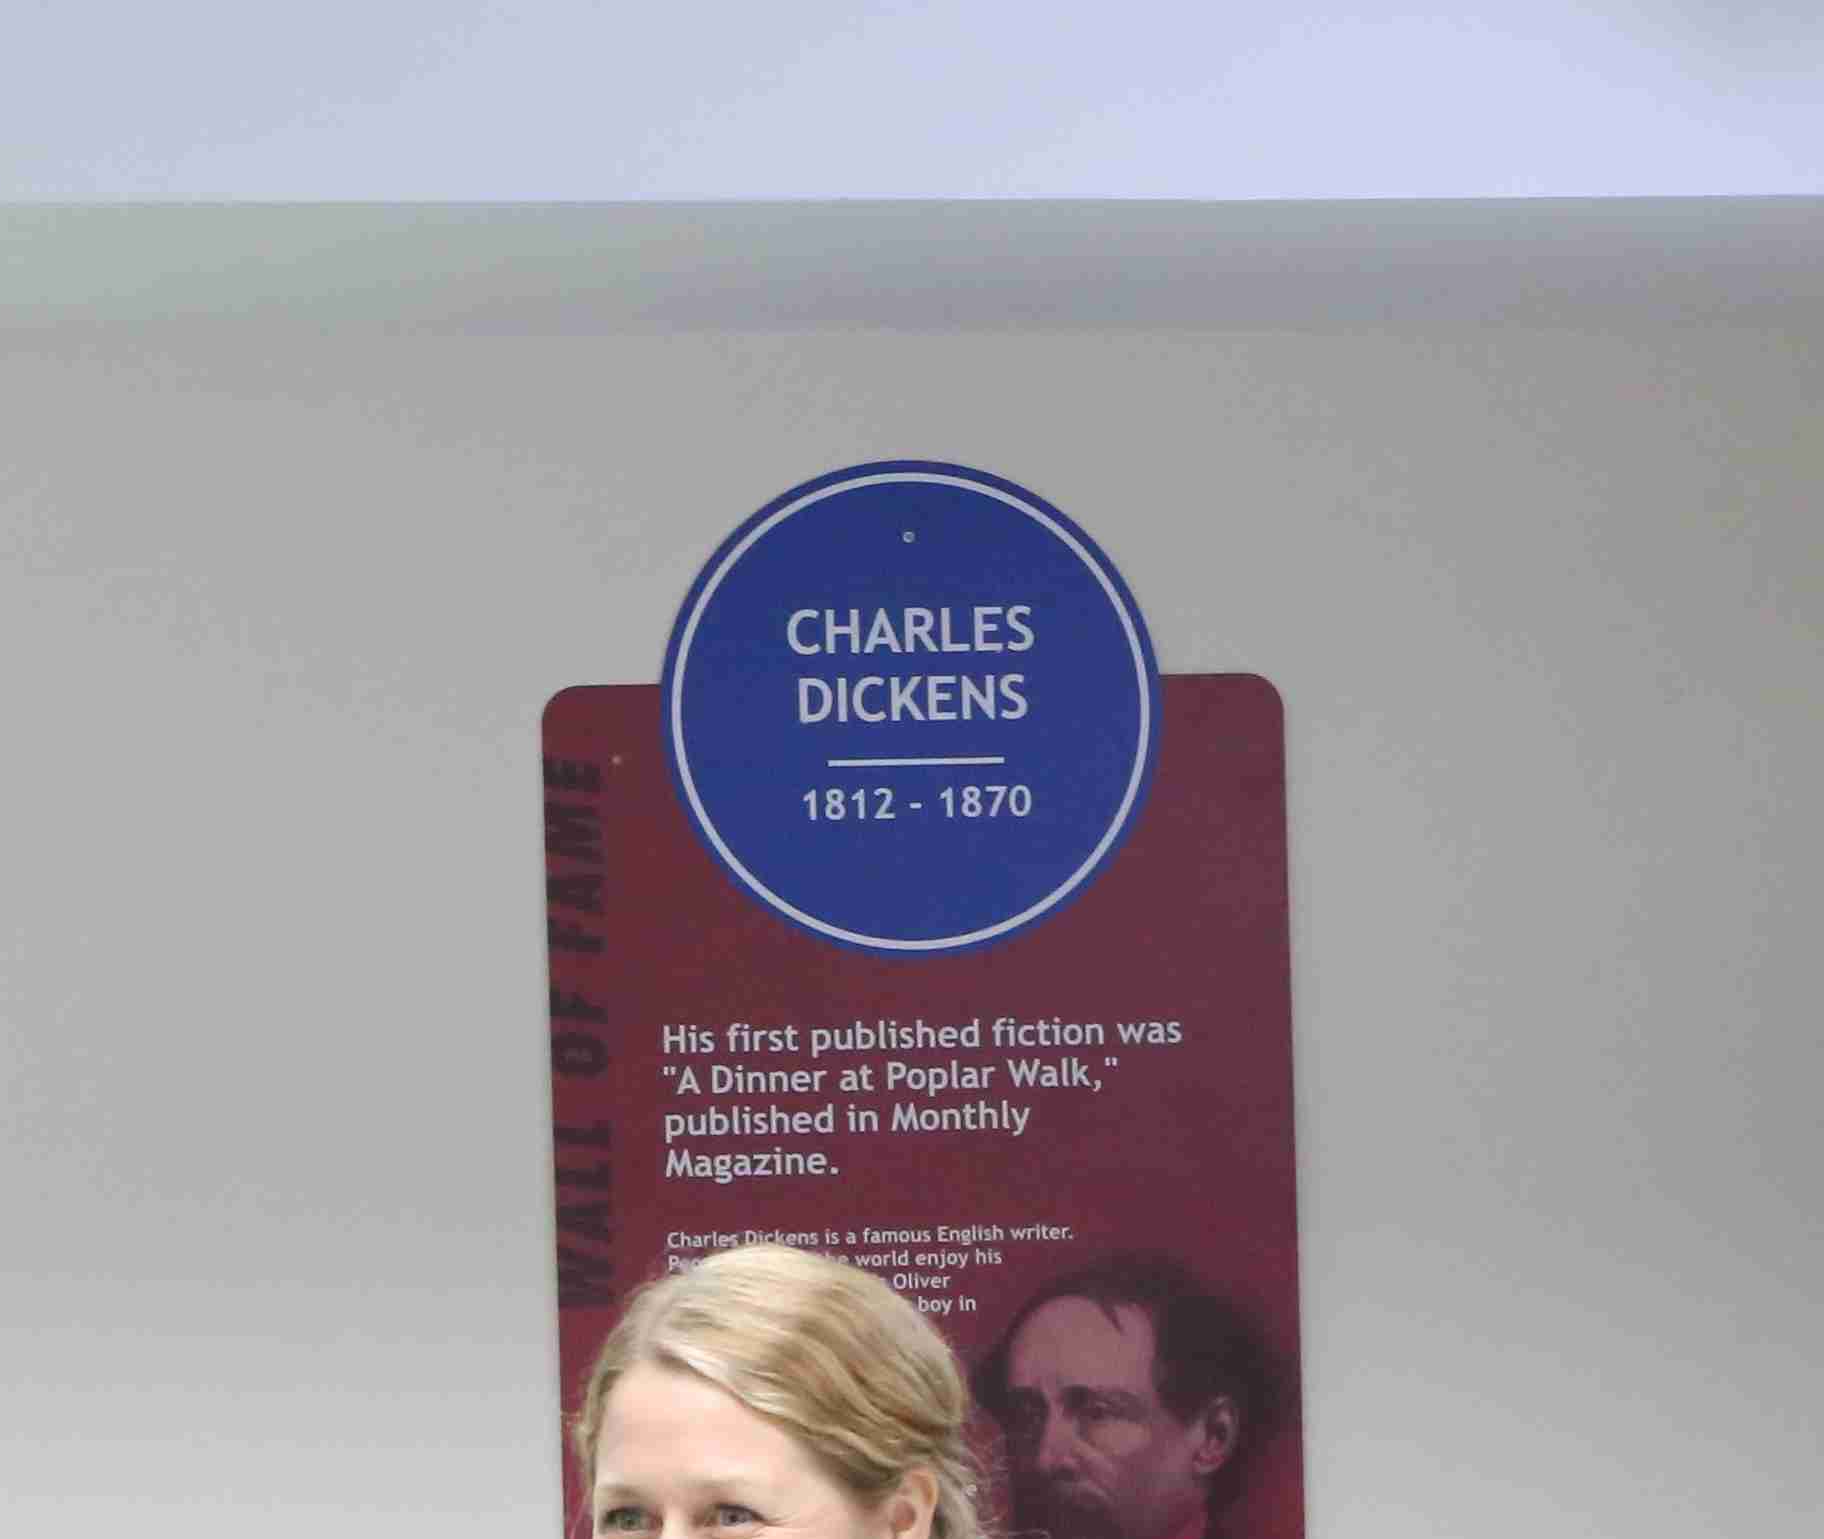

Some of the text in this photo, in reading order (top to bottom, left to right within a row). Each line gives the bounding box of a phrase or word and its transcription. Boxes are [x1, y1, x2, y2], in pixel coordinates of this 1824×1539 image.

[786, 605, 1035, 656] CHARLES
[798, 673, 1028, 724] DICKENS
[803, 787, 896, 821] 1812
[939, 784, 1033, 818] 1870
[543, 758, 607, 954] FAME
[548, 988, 608, 1079] OF
[663, 1017, 1182, 1058] His first published fiction was
[663, 1057, 1118, 1097] "A Dinner at Poplar Walk,"
[665, 1100, 1030, 1143] published in Monthly
[666, 1147, 840, 1184] Magazine.
[668, 1225, 1074, 1249] Charles Dickens is a famous English writer.
[855, 1249, 909, 1266] world
[915, 1249, 968, 1269] enjoy
[975, 1249, 1002, 1265] his
[894, 1273, 951, 1290] Oliver
[918, 1294, 976, 1314] boy in
